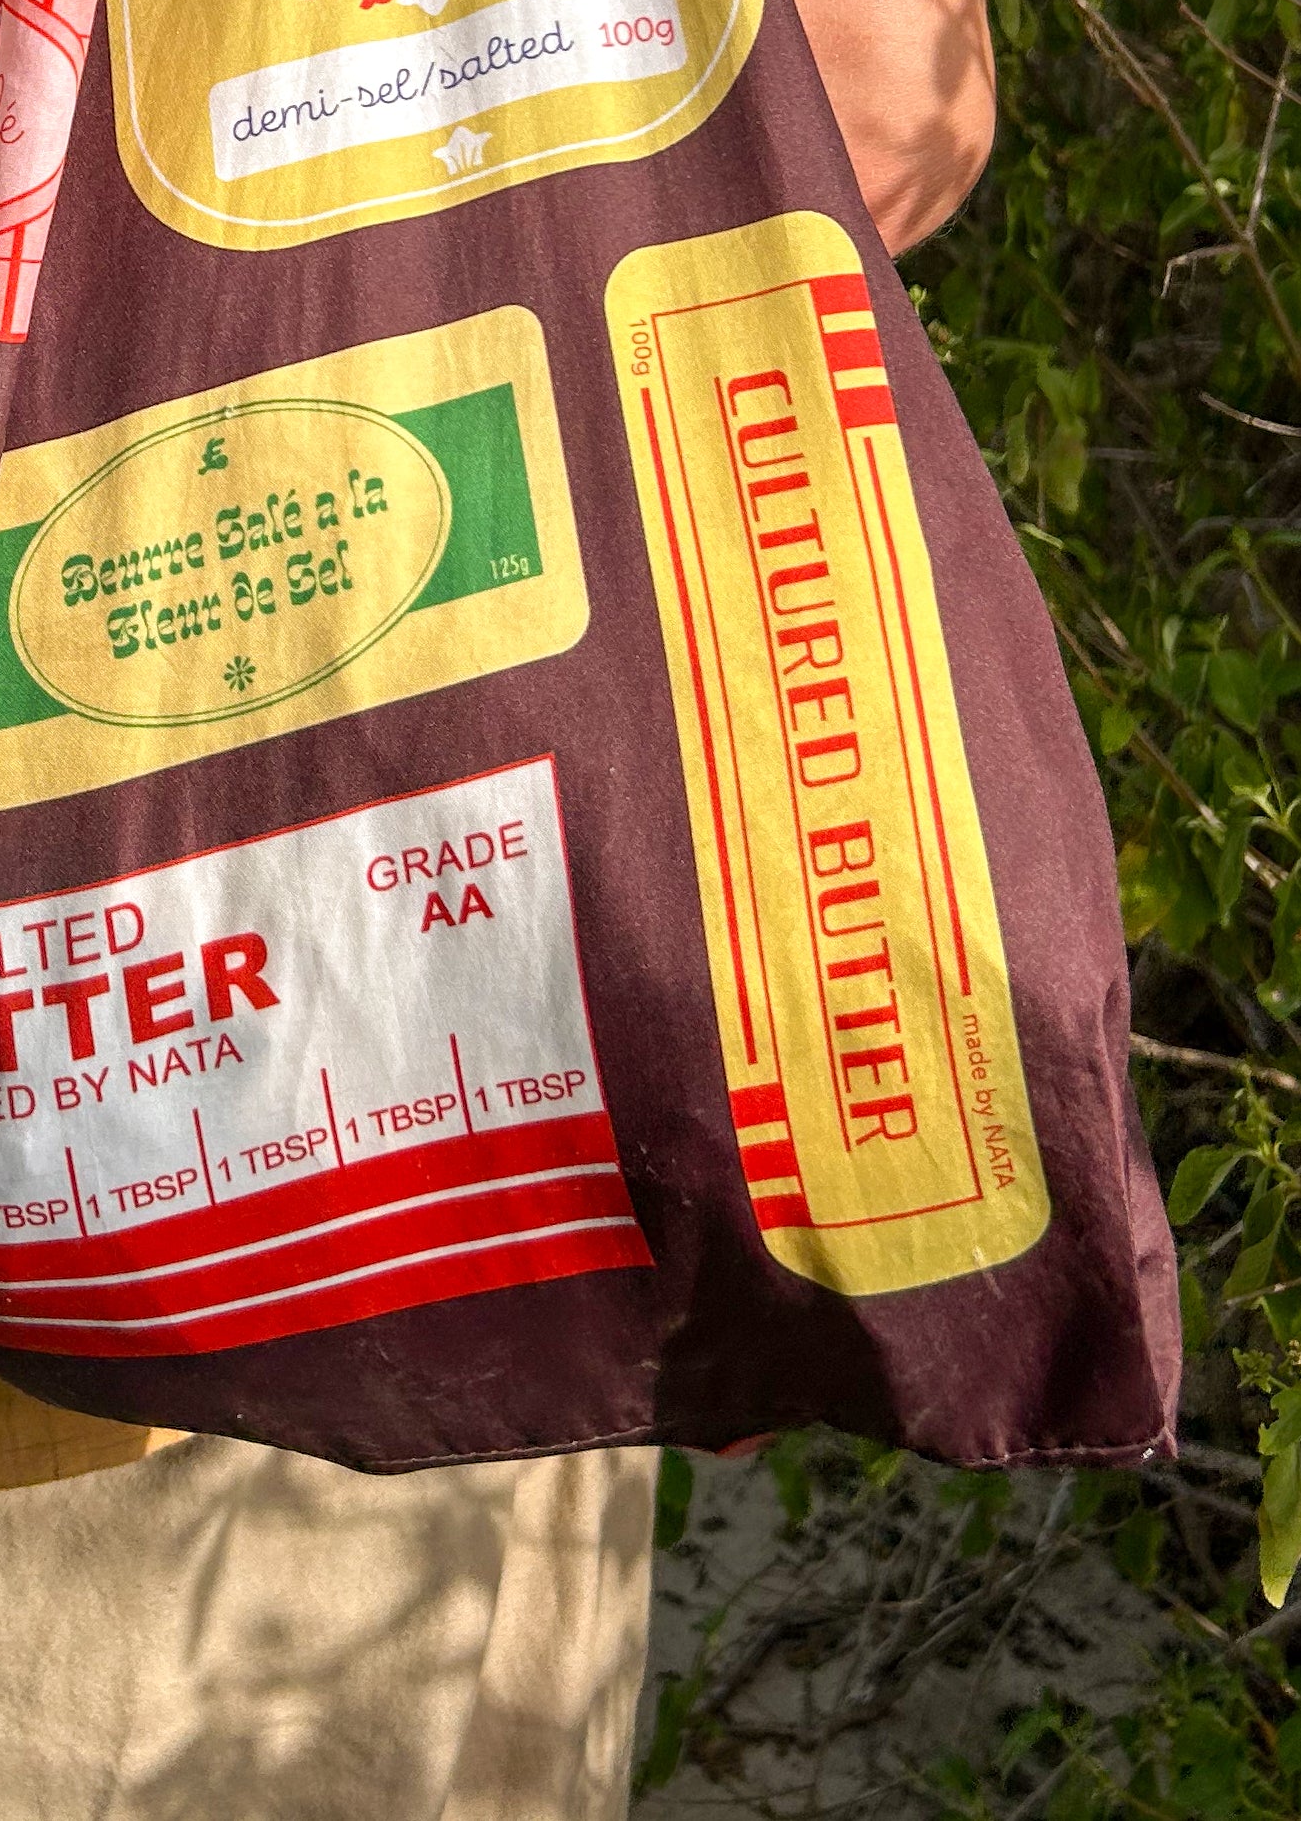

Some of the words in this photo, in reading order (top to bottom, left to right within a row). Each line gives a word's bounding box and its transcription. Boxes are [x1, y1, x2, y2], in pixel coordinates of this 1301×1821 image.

[233, 21, 574, 141] demi-sel/salted
[599, 17, 675, 47] 100g
[629, 319, 652, 376] 100g
[61, 532, 204, 607] Beurre
[216, 489, 303, 561] Salé
[348, 469, 388, 519] la
[489, 554, 530, 580] 125g
[107, 592, 222, 659] Fleur
[231, 571, 277, 622] de
[286, 539, 354, 606] Sel
[727, 369, 864, 789] CULTURED
[809, 819, 918, 1148] BUTTER
[365, 820, 528, 892] GRADE
[420, 884, 495, 932] AA
[53, 1066, 109, 1110] BY
[127, 1032, 244, 1093] NATA
[963, 1013, 991, 1079] made
[344, 1117, 362, 1144] 1
[368, 1093, 457, 1136] TBSP
[473, 1086, 491, 1113] 1
[496, 1070, 587, 1110] TBSP
[972, 1088, 997, 1116] by
[217, 1157, 232, 1182] 1
[239, 1127, 328, 1177] TBSP
[983, 1124, 1016, 1190] NATA
[86, 1195, 101, 1219] 1
[109, 1168, 198, 1212] TBSP
